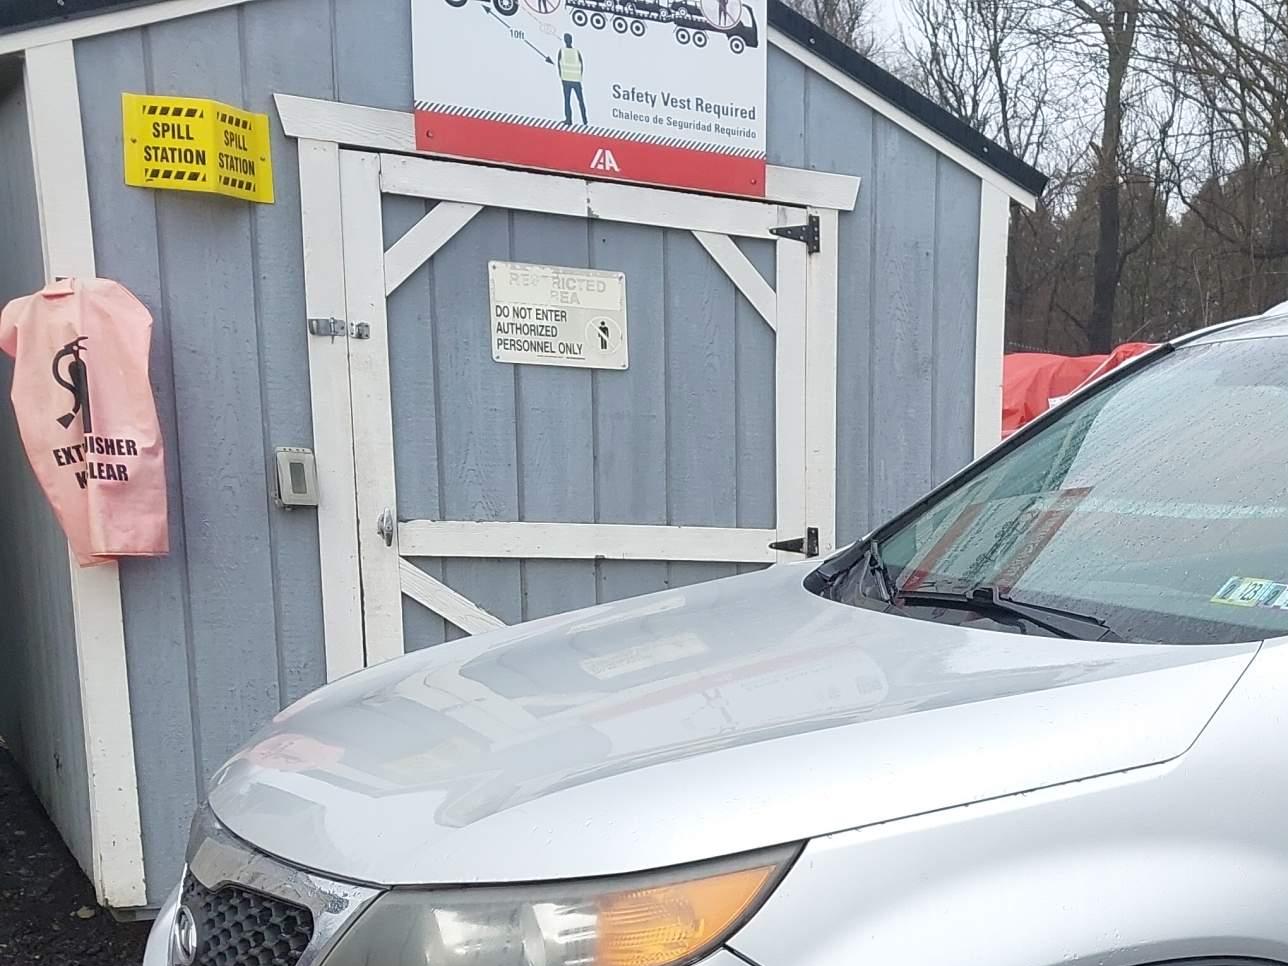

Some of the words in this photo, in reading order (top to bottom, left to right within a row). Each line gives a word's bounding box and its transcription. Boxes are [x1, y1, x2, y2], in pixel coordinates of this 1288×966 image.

[509, 29, 525, 40] 10ft
[612, 84, 657, 107] Safety
[661, 91, 692, 110] Vest
[695, 97, 756, 120] Required
[612, 108, 650, 123] Chaleco
[652, 114, 664, 125] de
[666, 116, 712, 132] Seguridad
[152, 121, 194, 141] SPILL
[223, 130, 248, 151] SPILL
[144, 145, 206, 166] STATION
[218, 152, 255, 176] STATION
[495, 305, 509, 318] DO
[512, 306, 533, 320] NOT
[535, 308, 567, 322] ENTER
[496, 322, 558, 338] AUTHORIZED
[496, 338, 556, 354] PERSONNEL
[558, 342, 583, 355] ONLY
